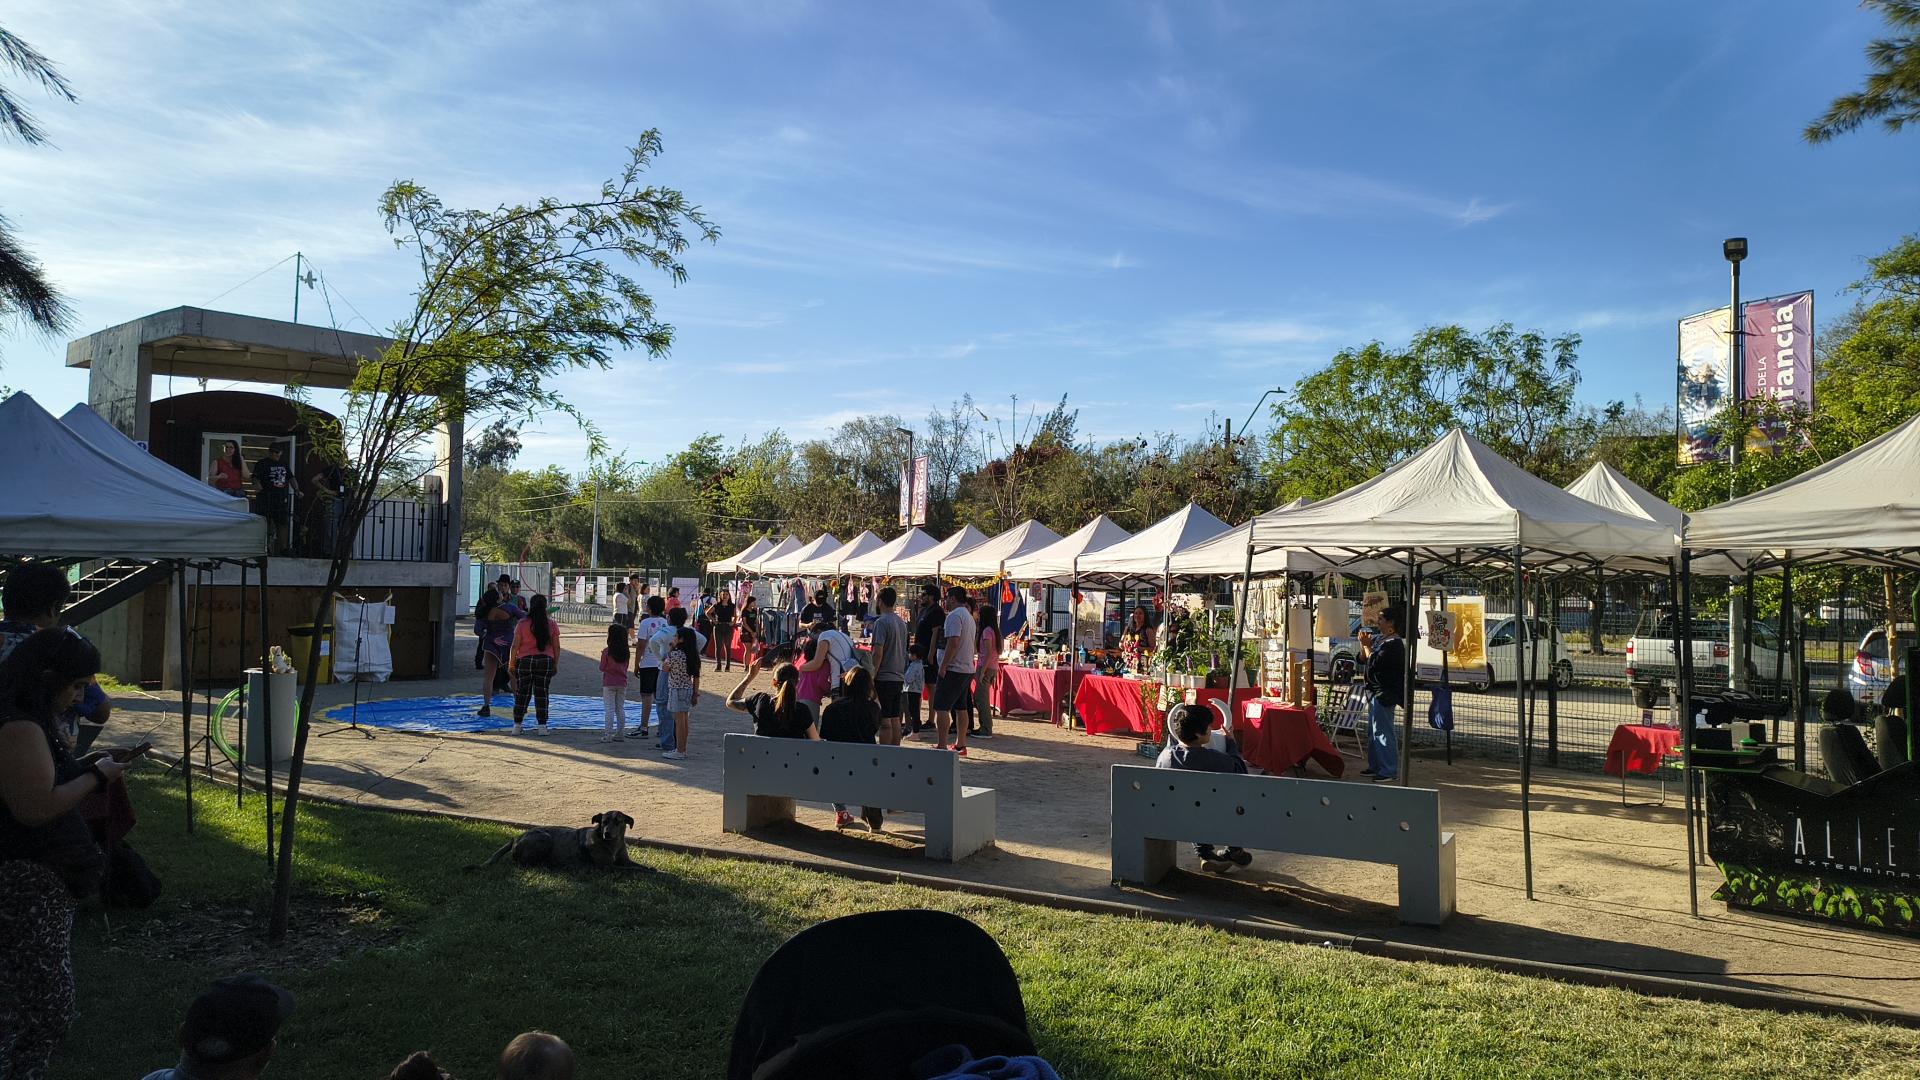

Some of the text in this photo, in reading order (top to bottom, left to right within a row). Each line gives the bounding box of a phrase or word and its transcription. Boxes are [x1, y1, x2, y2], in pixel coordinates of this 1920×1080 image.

[1757, 356, 1767, 429] PARE DE LA
[1794, 816, 1920, 868] ALIE
